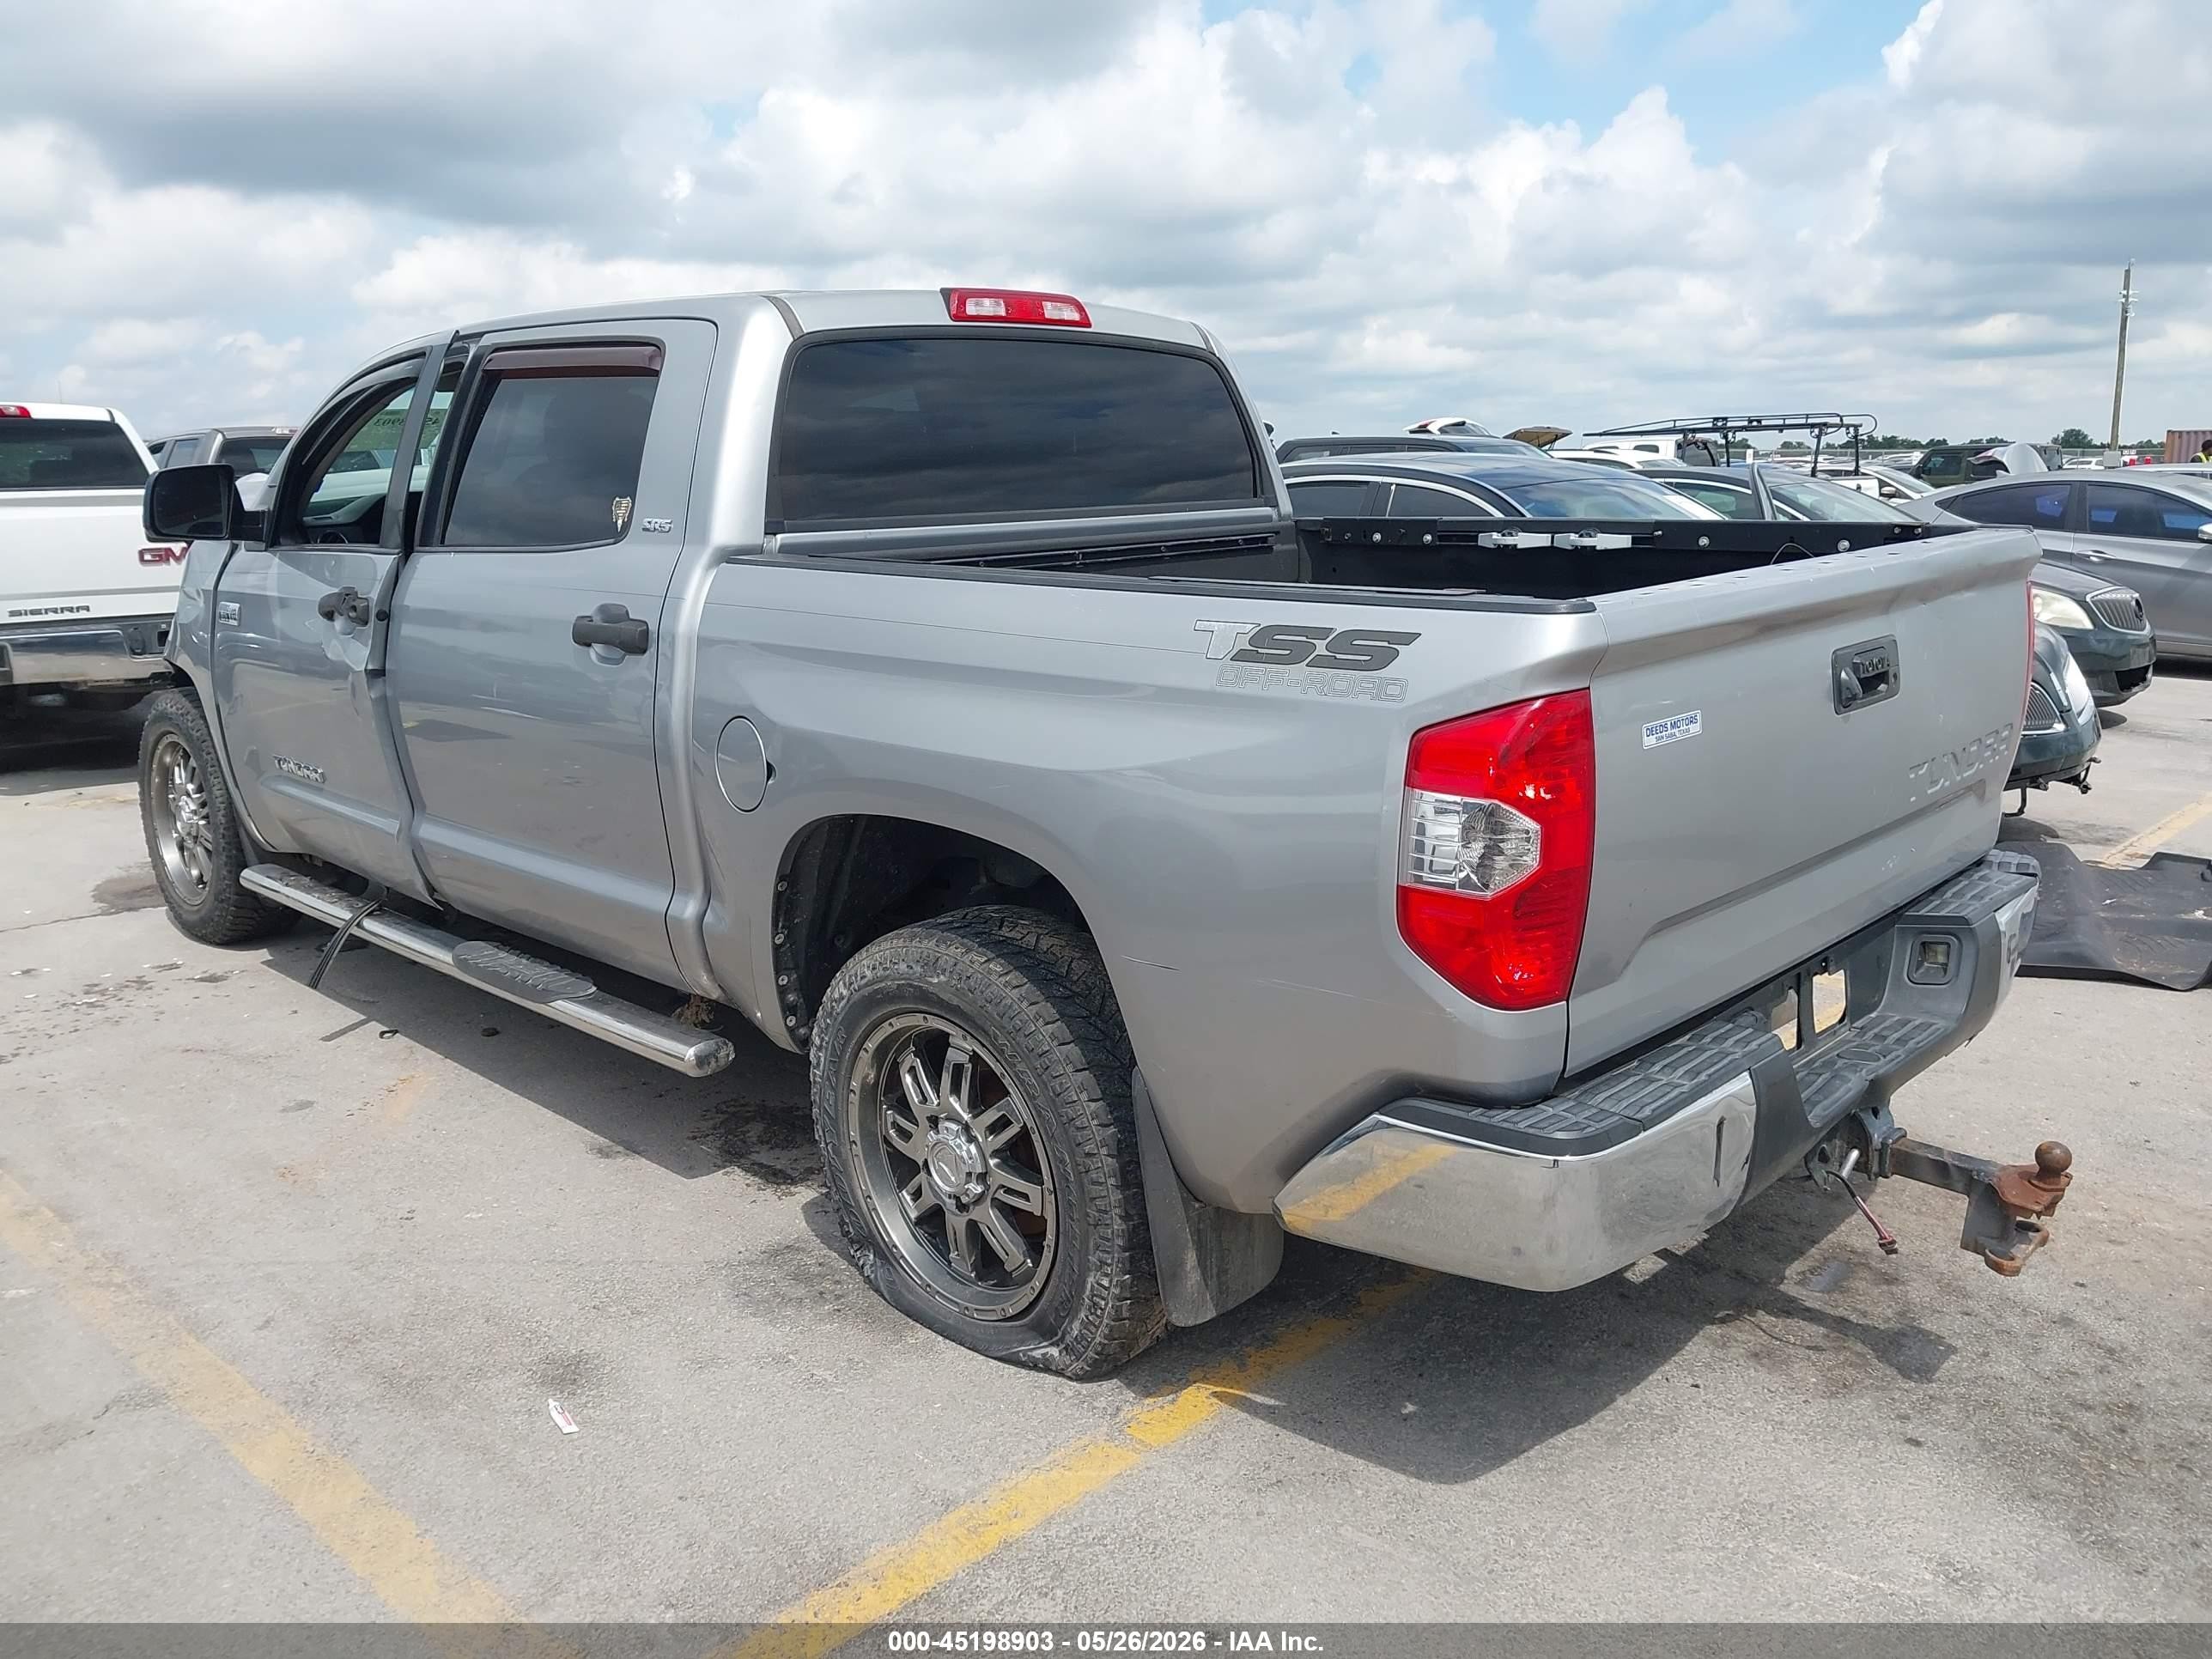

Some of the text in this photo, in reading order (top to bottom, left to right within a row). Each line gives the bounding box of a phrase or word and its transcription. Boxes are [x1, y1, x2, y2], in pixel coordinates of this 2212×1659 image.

[138, 547, 188, 567] GM
[7, 605, 91, 617] SIERRA
[1194, 619, 1422, 672] TSS
[1216, 664, 1409, 702] OFF-ROAD
[1645, 714, 1698, 738] DEEDS MOTORS
